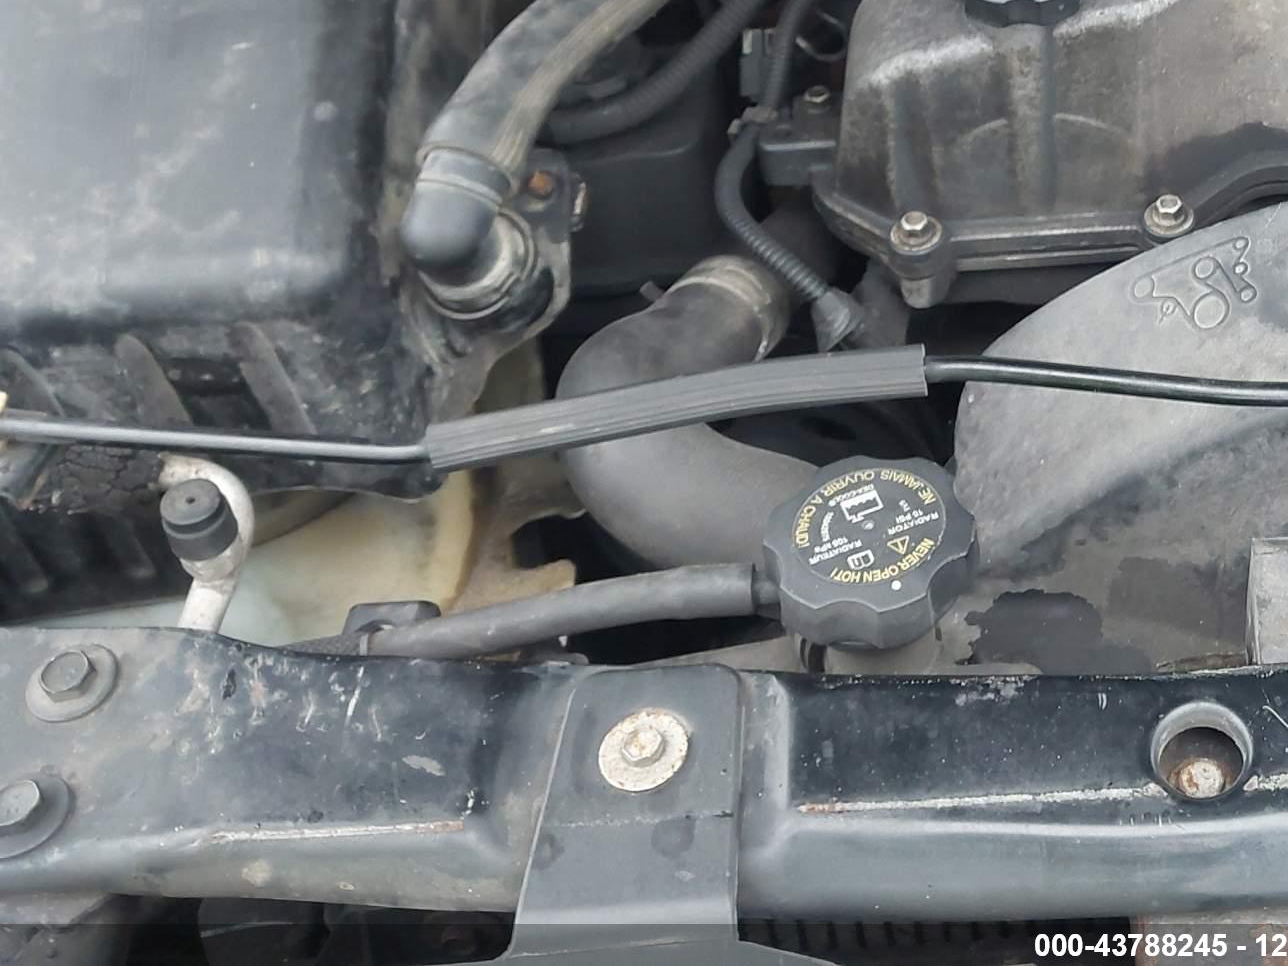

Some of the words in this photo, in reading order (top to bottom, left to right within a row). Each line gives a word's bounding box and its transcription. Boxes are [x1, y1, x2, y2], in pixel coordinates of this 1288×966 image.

[821, 471, 874, 496] OUVRIR
[879, 469, 923, 492] JAMAIS
[918, 487, 937, 505] NE
[796, 505, 816, 548] CHAUD!
[887, 511, 939, 535] RADIATOR
[808, 539, 862, 565] RADIATEUR
[897, 538, 935, 570] NEVER
[831, 567, 861, 582] HOT!
[863, 563, 899, 582] OPEN
